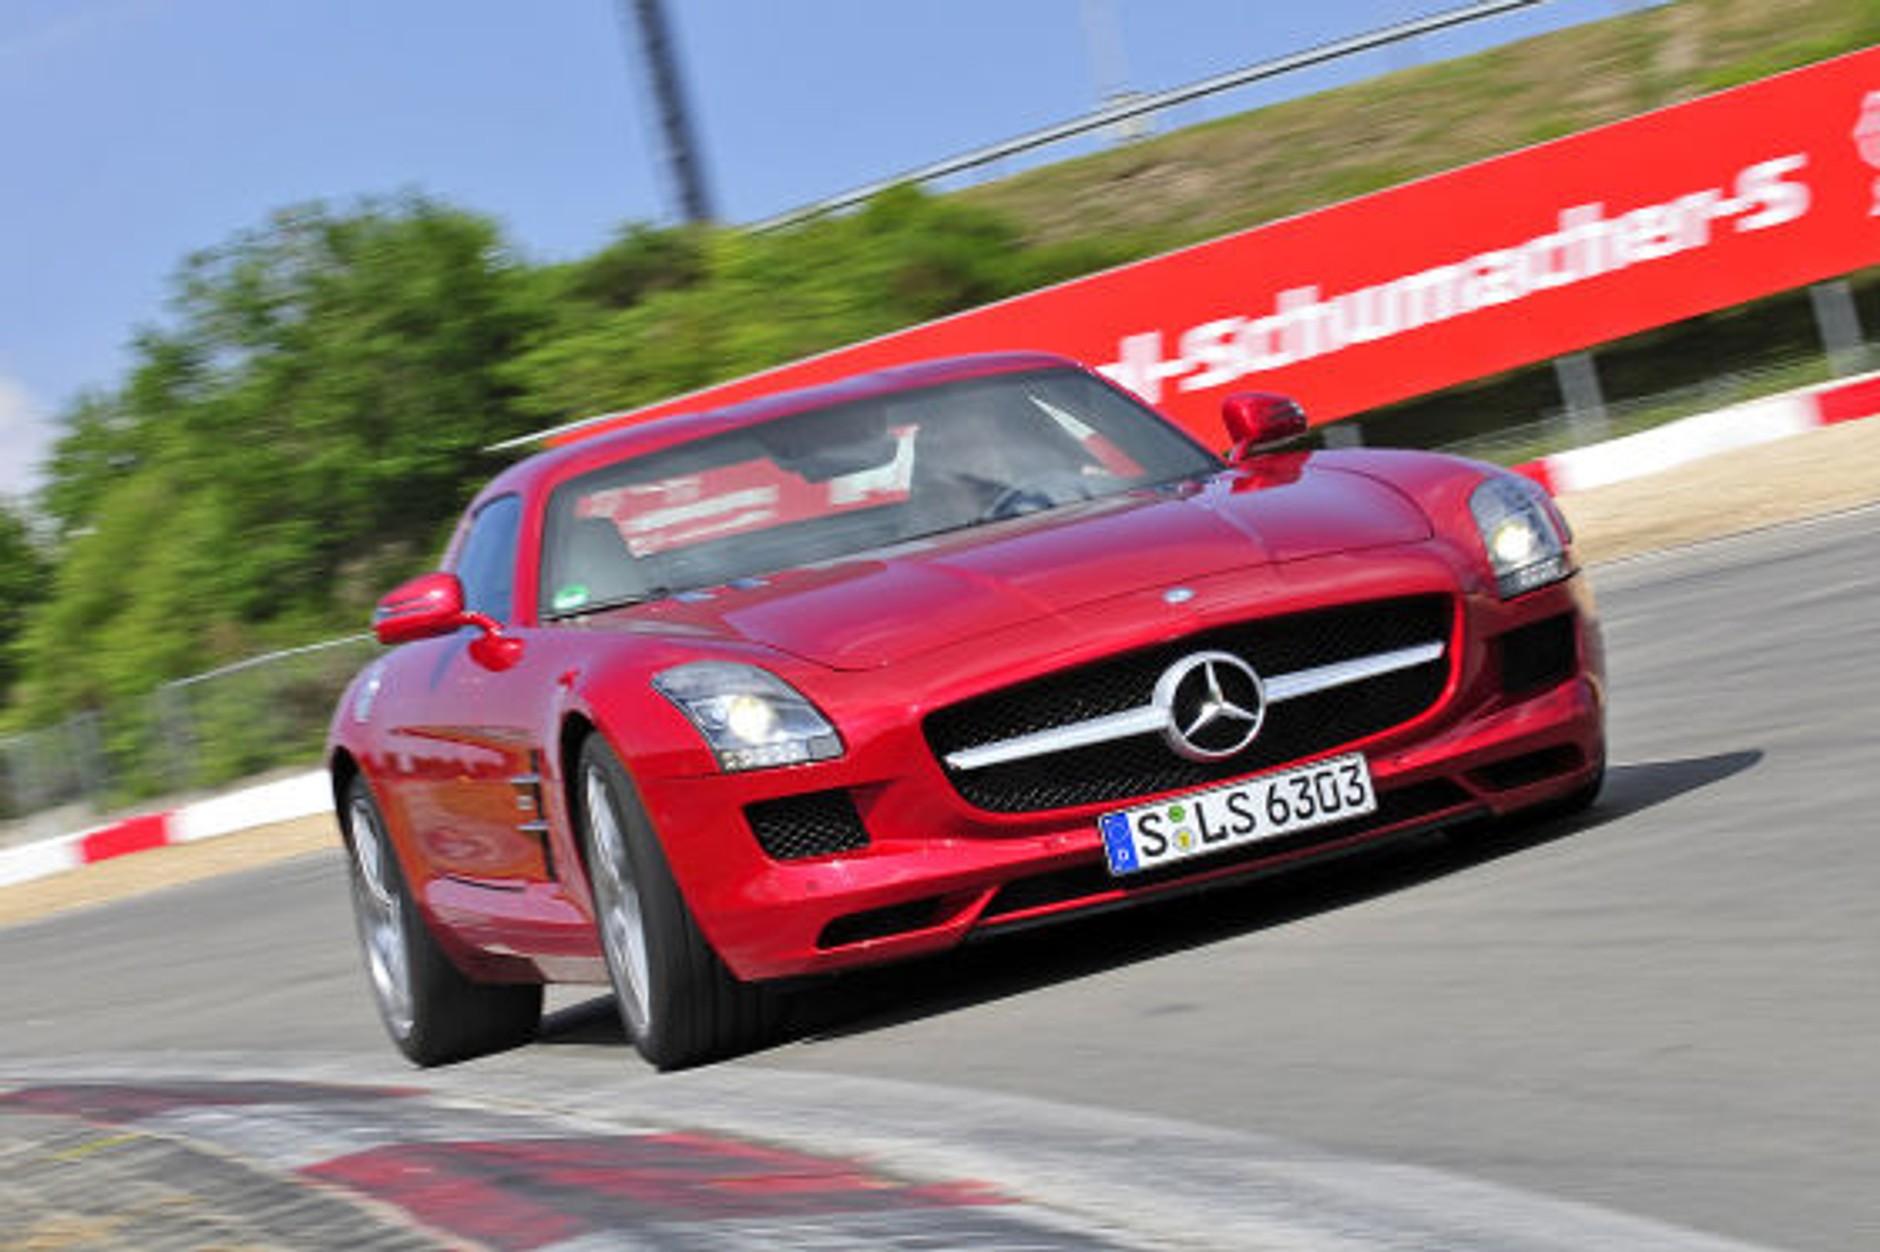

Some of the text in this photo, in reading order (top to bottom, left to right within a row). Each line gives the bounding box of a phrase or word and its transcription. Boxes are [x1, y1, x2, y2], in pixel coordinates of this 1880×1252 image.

[1095, 152, 1812, 404] l-Schumacher-S
[1137, 764, 1366, 858] S LS 6303
